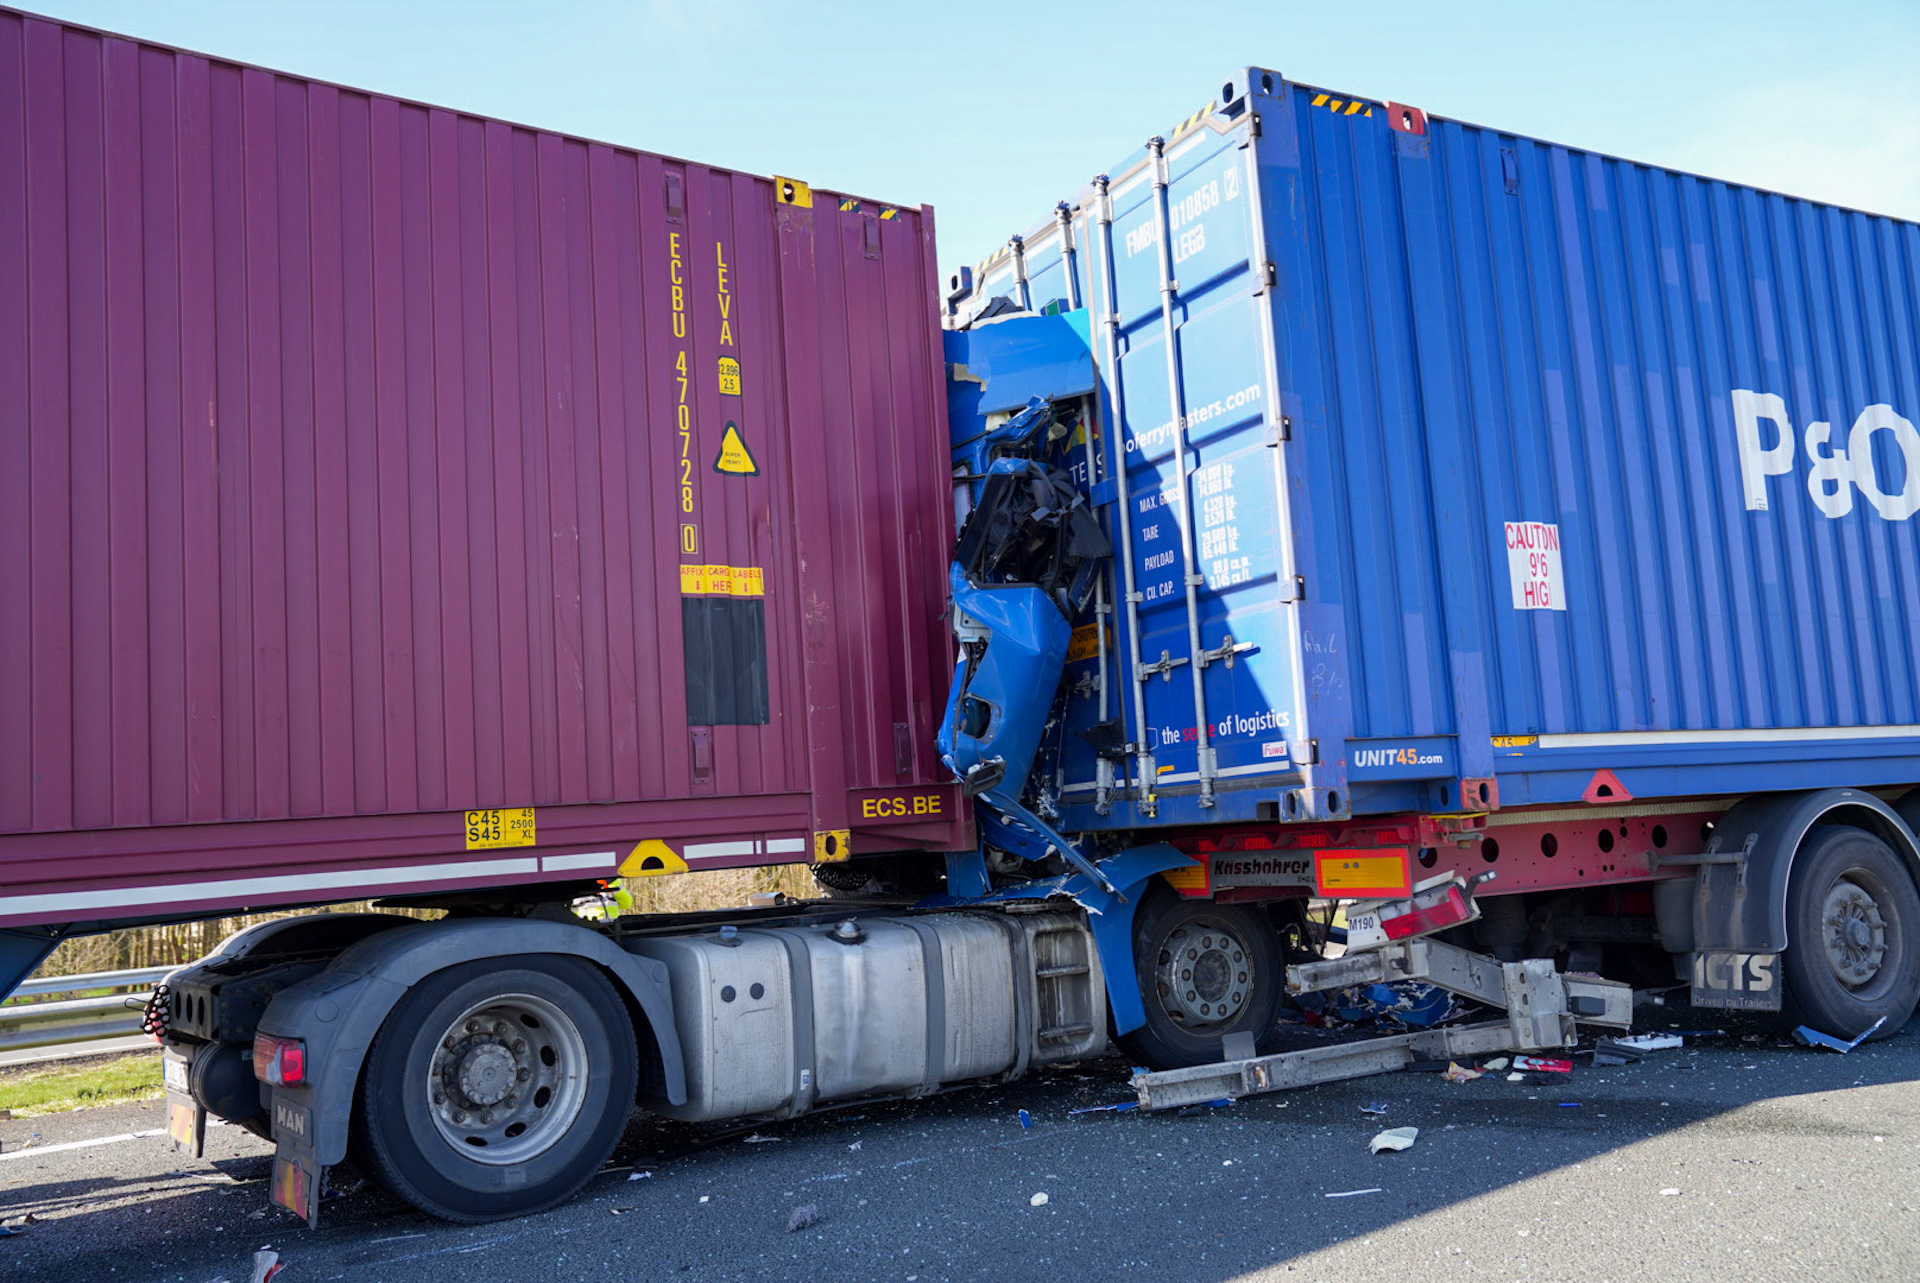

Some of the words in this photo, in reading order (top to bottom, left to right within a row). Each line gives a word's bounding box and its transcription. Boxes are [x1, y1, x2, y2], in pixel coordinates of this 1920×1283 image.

[1171, 180, 1220, 231] 010858
[669, 232, 685, 338] ECBU
[716, 241, 734, 346] LEVA
[676, 351, 694, 513] 470728
[1731, 388, 1920, 521] P&O
[1139, 495, 1158, 513] MAX.
[1142, 524, 1160, 542] TARE
[1144, 550, 1175, 571] PAYLOAD
[681, 567, 704, 576] AFFIX
[708, 567, 730, 577] CARG
[733, 569, 761, 579] LABELS
[712, 580, 732, 592] HER
[1146, 585, 1158, 600] CU.
[1159, 580, 1175, 597] CAP.
[1524, 581, 1552, 607] HIG
[1162, 726, 1180, 745] the
[1218, 715, 1232, 736] of
[1235, 709, 1290, 737] logistics
[1264, 743, 1284, 756] Fuwa
[1354, 748, 1443, 767] UNIT45.com
[521, 808, 533, 818] 45
[862, 794, 942, 818] ECS.BE
[467, 810, 500, 826] C45
[510, 819, 533, 829] 2500
[468, 826, 501, 842] S45
[522, 829, 533, 839] XL
[1694, 995, 1724, 1007] Driven
[1726, 997, 1737, 1008] by
[276, 1104, 305, 1136] MAN
